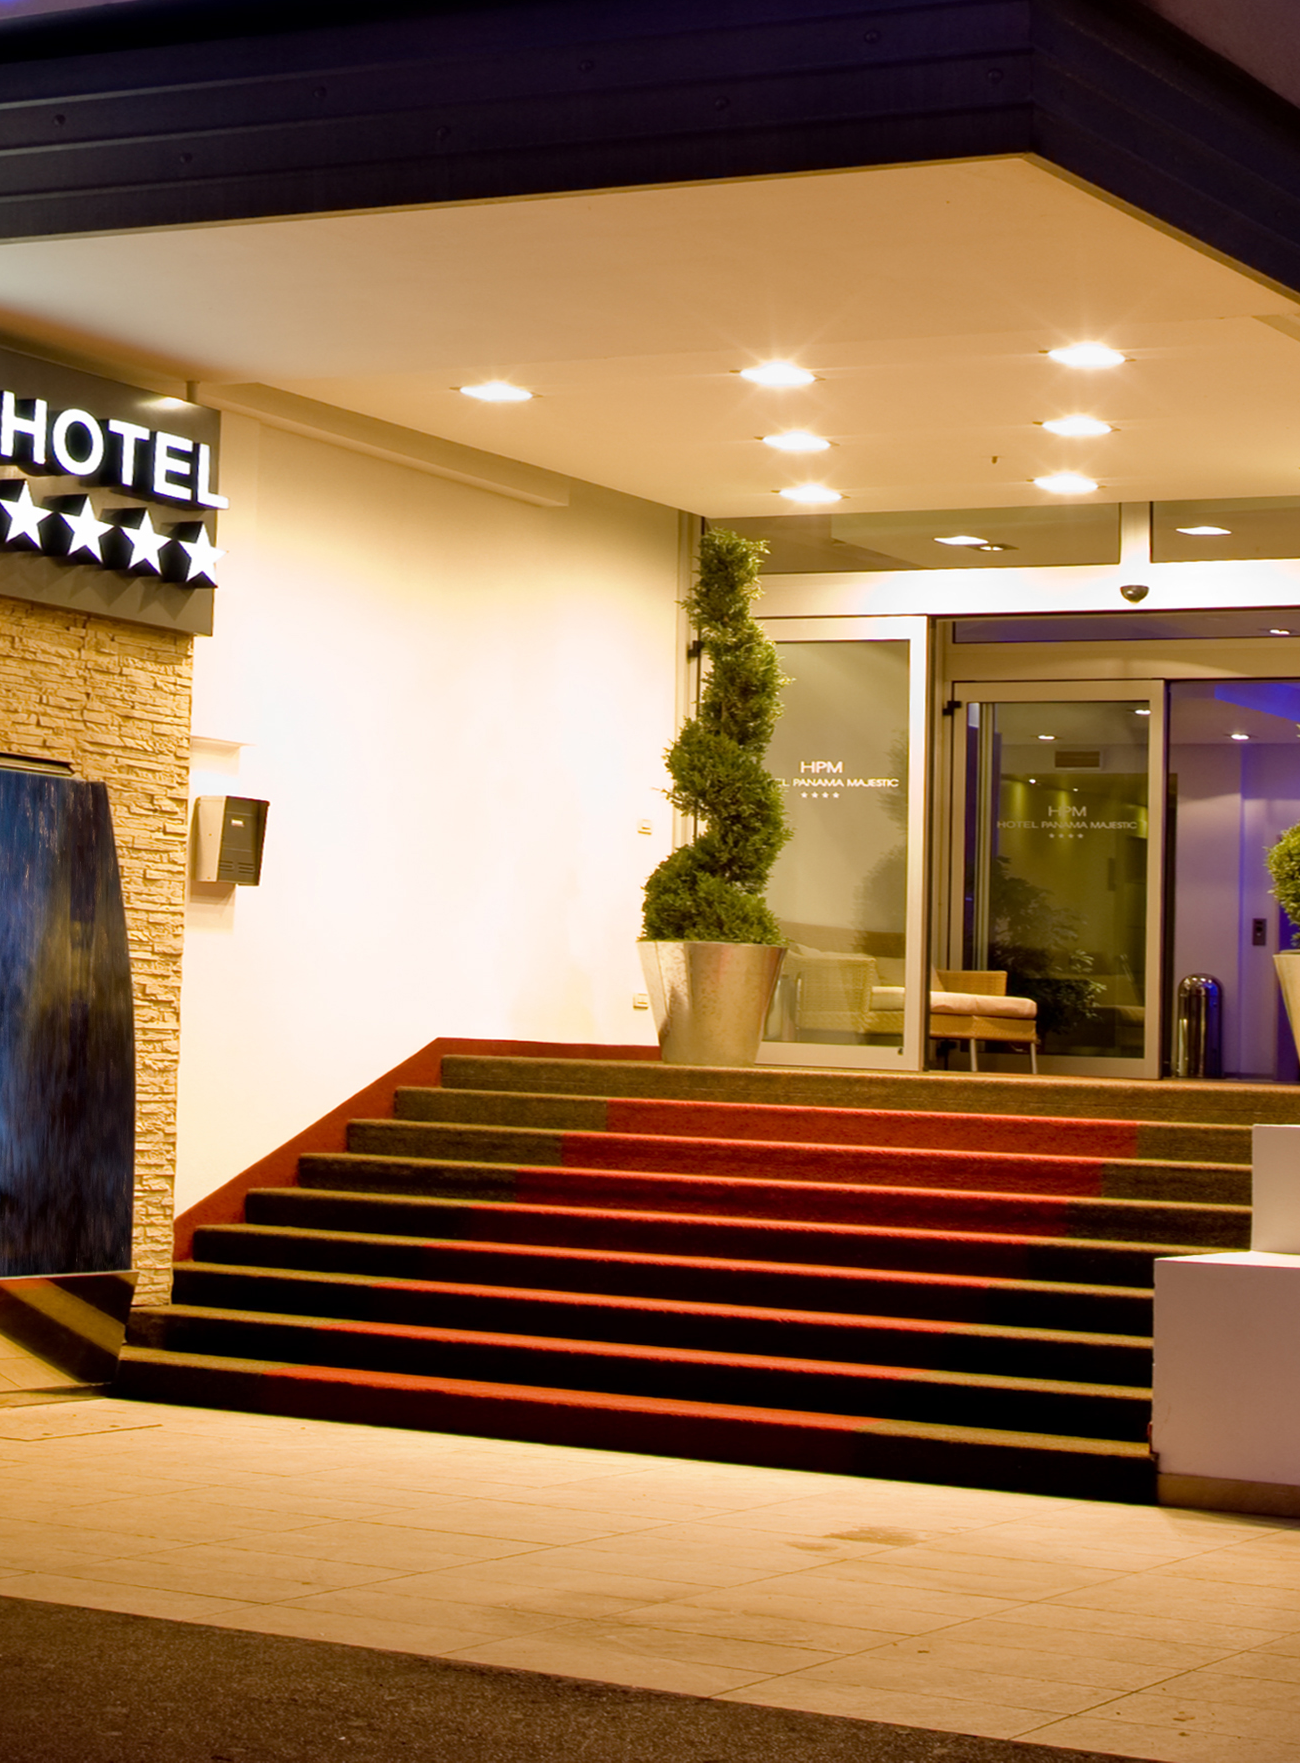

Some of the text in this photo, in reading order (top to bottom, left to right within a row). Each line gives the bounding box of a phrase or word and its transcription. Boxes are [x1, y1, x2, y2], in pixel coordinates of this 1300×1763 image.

[800, 760, 844, 774] HPM
[792, 778, 845, 788] PANAMA
[846, 778, 900, 788] MAJESTIC
[1047, 805, 1088, 818] HPM
[996, 820, 1138, 830] HOTEL PANAMA MAJESTIC
